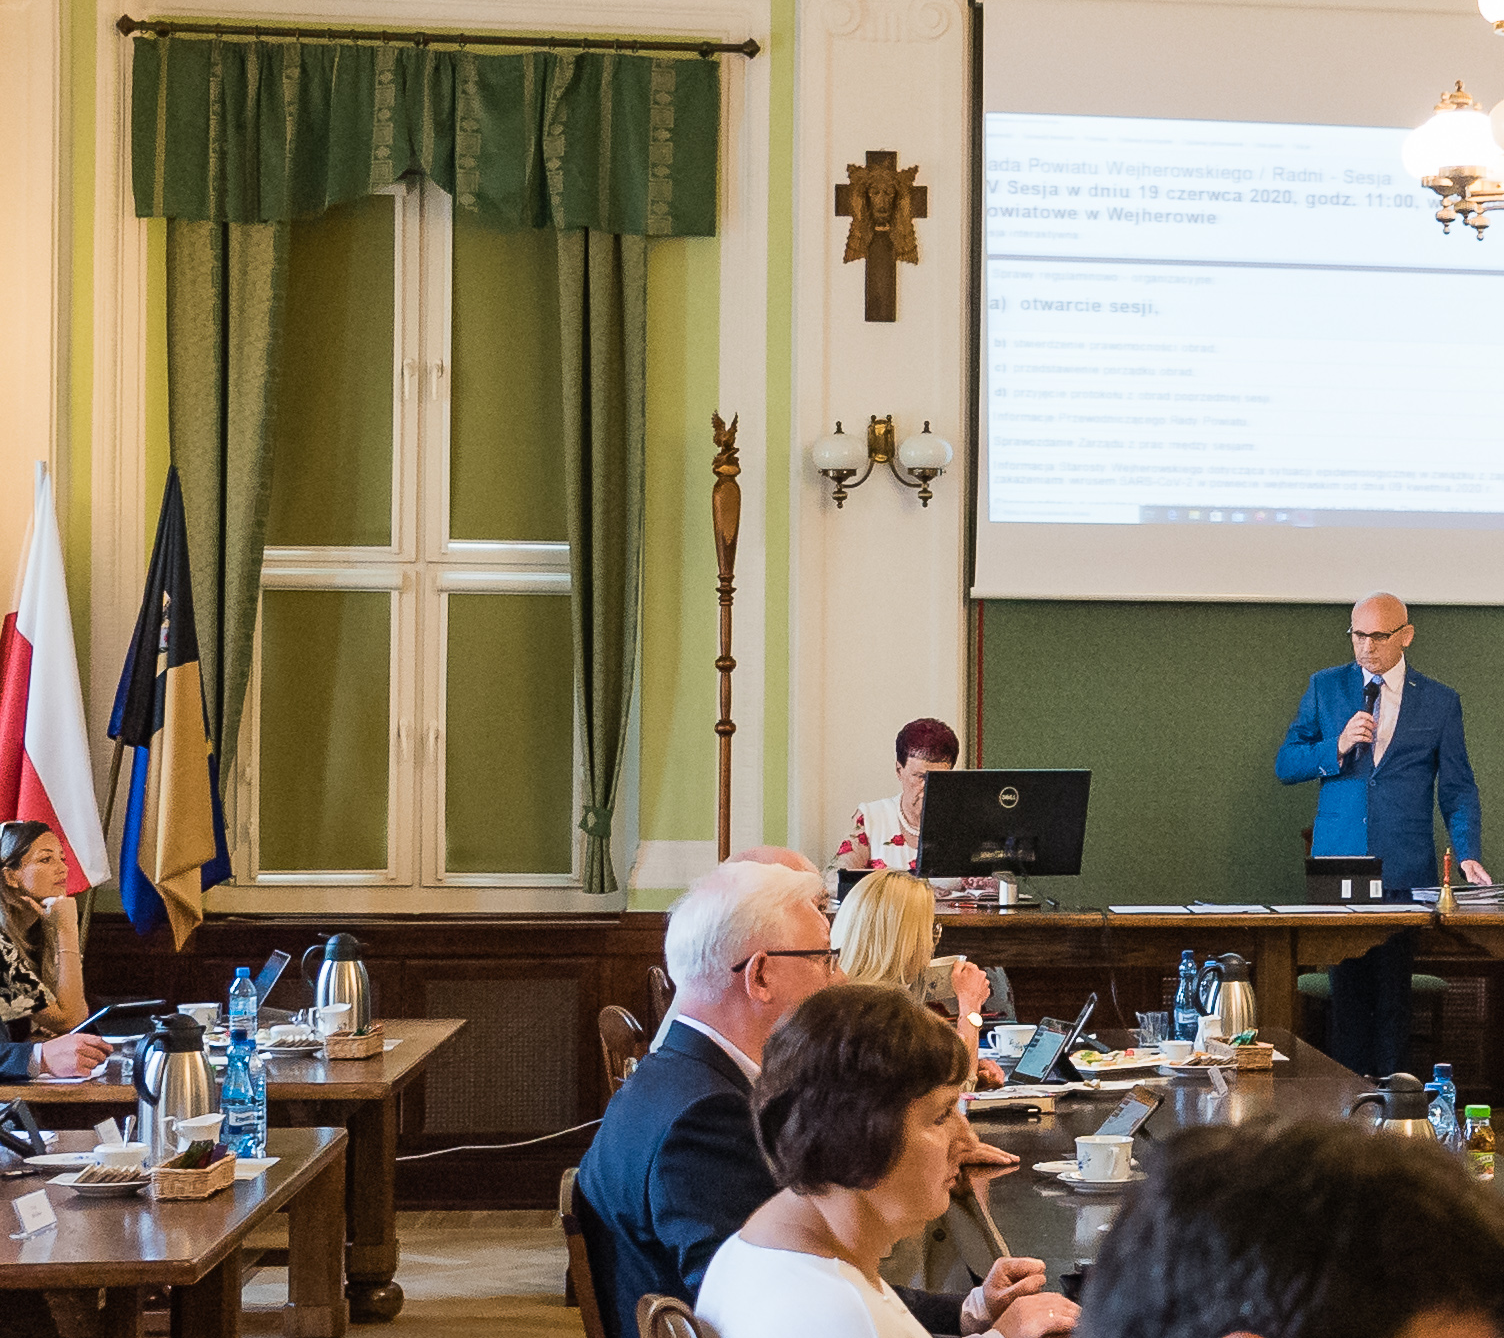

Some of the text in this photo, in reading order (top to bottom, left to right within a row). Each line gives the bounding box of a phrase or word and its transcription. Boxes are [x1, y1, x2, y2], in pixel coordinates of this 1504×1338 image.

[1028, 157, 1098, 175] Powiatu
[1106, 161, 1254, 182] Wejherowskiego
[1272, 167, 1324, 183] Radni
[1343, 169, 1394, 187] Sesja
[1007, 179, 1060, 198] Sesja
[1067, 184, 1082, 197] w
[1088, 183, 1131, 199] dniu
[1140, 185, 1160, 199] 19
[1166, 188, 1243, 203] czerwca
[1306, 192, 1358, 209] godz.
[1086, 208, 1100, 221] w
[1107, 206, 1217, 226] Wejherowie
[988, 296, 1008, 313] a)
[1020, 297, 1102, 313] otwarcie
